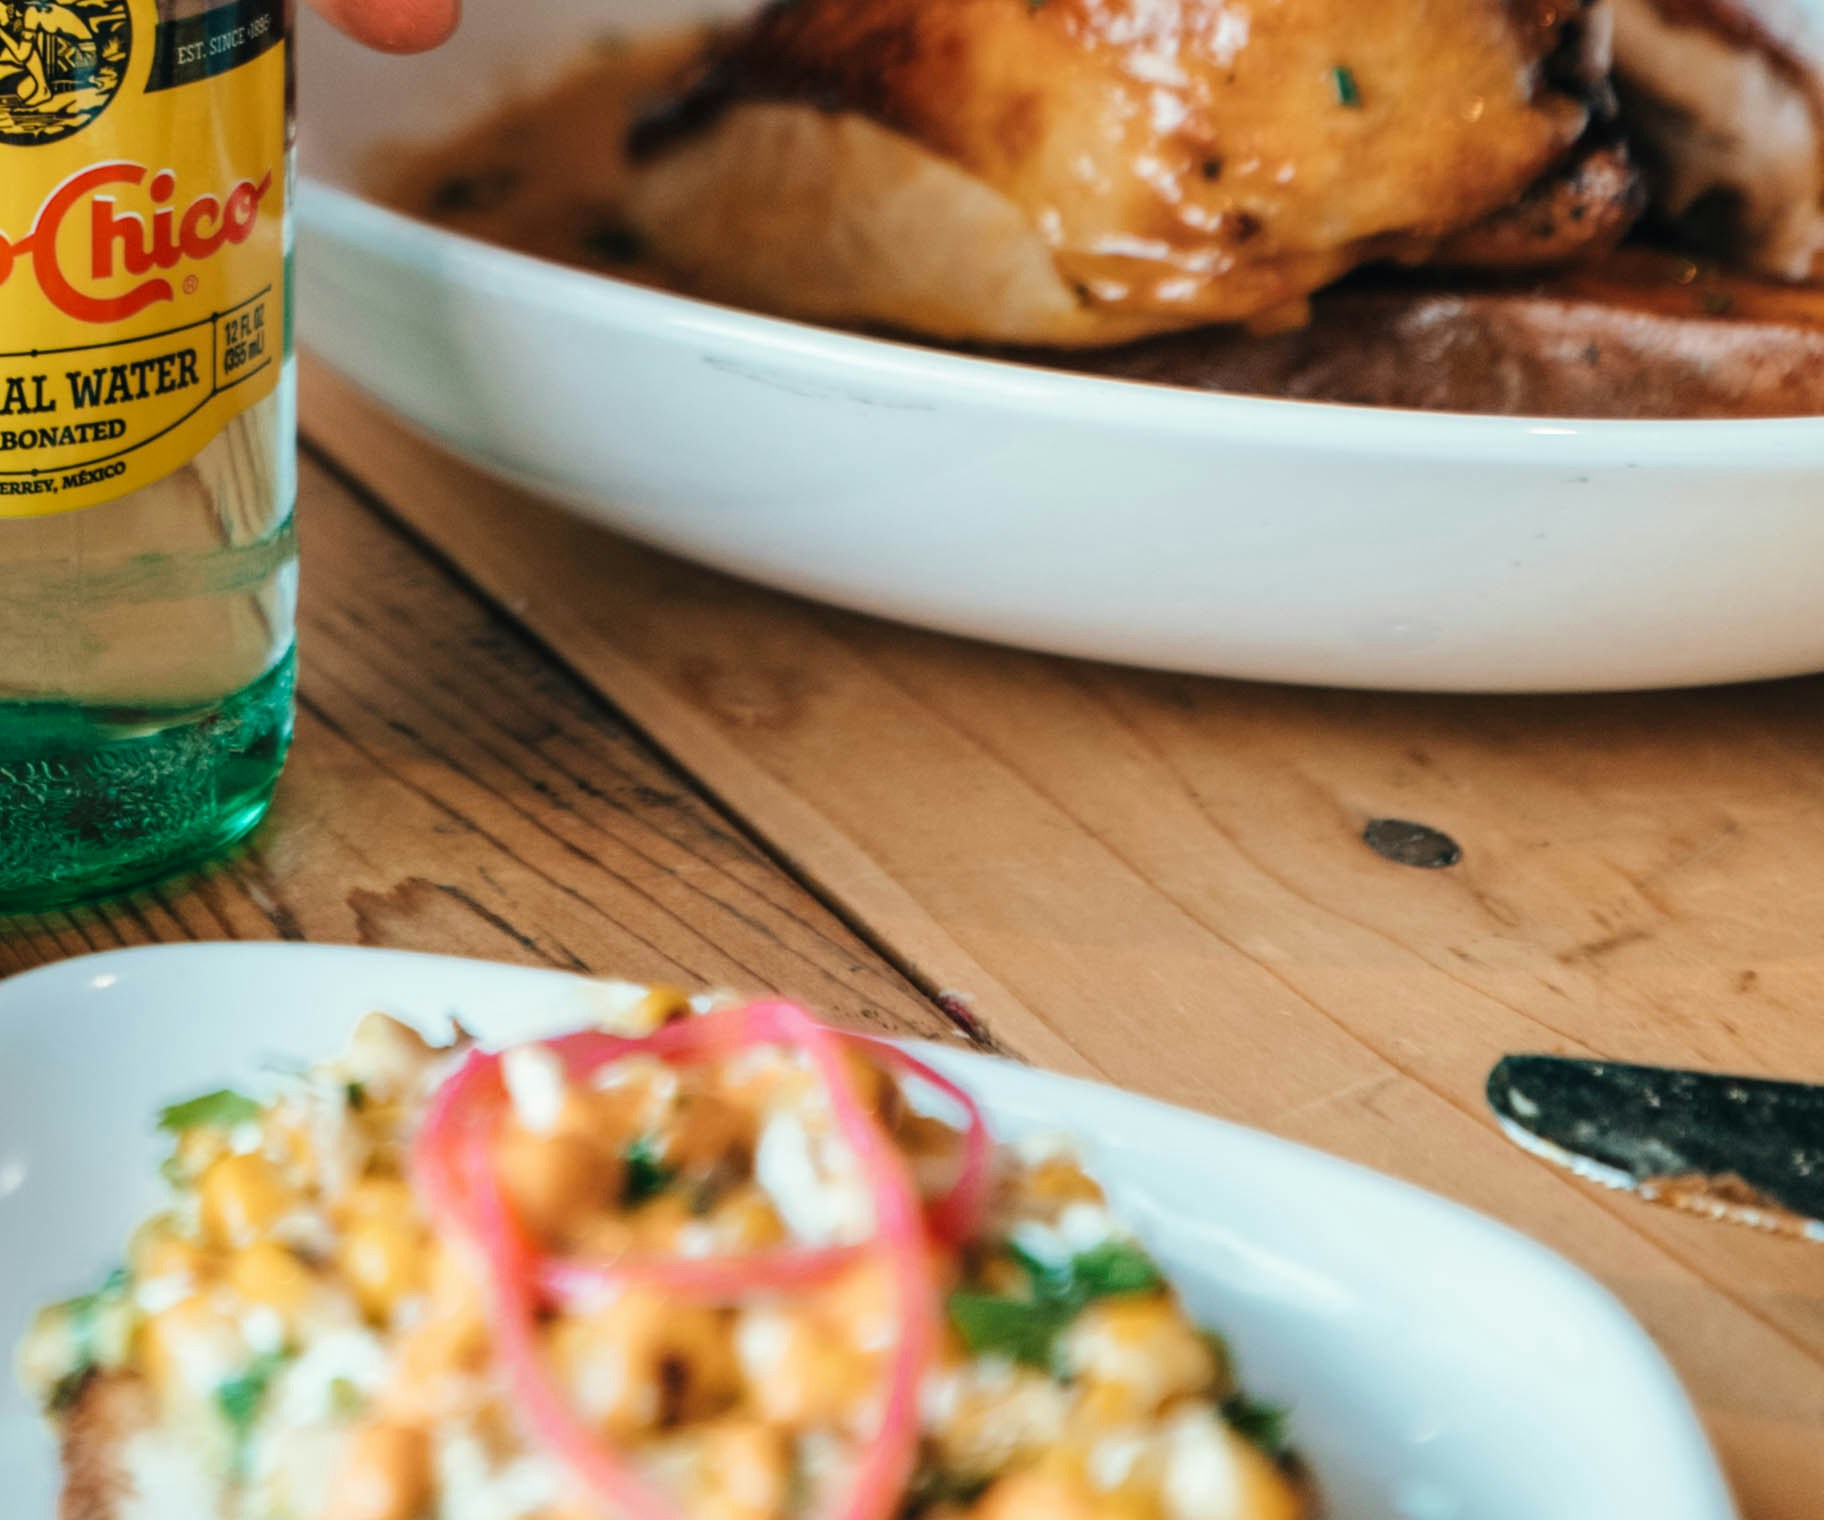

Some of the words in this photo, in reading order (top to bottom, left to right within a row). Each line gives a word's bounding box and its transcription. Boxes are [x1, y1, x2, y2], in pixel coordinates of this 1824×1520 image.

[177, 41, 207, 65] EST.
[209, 26, 245, 56] SINCE
[31, 160, 272, 324] Chico
[225, 320, 238, 346] 12
[254, 302, 266, 330] OZ
[65, 348, 200, 409] WATER
[61, 460, 127, 491] MÉXICO
